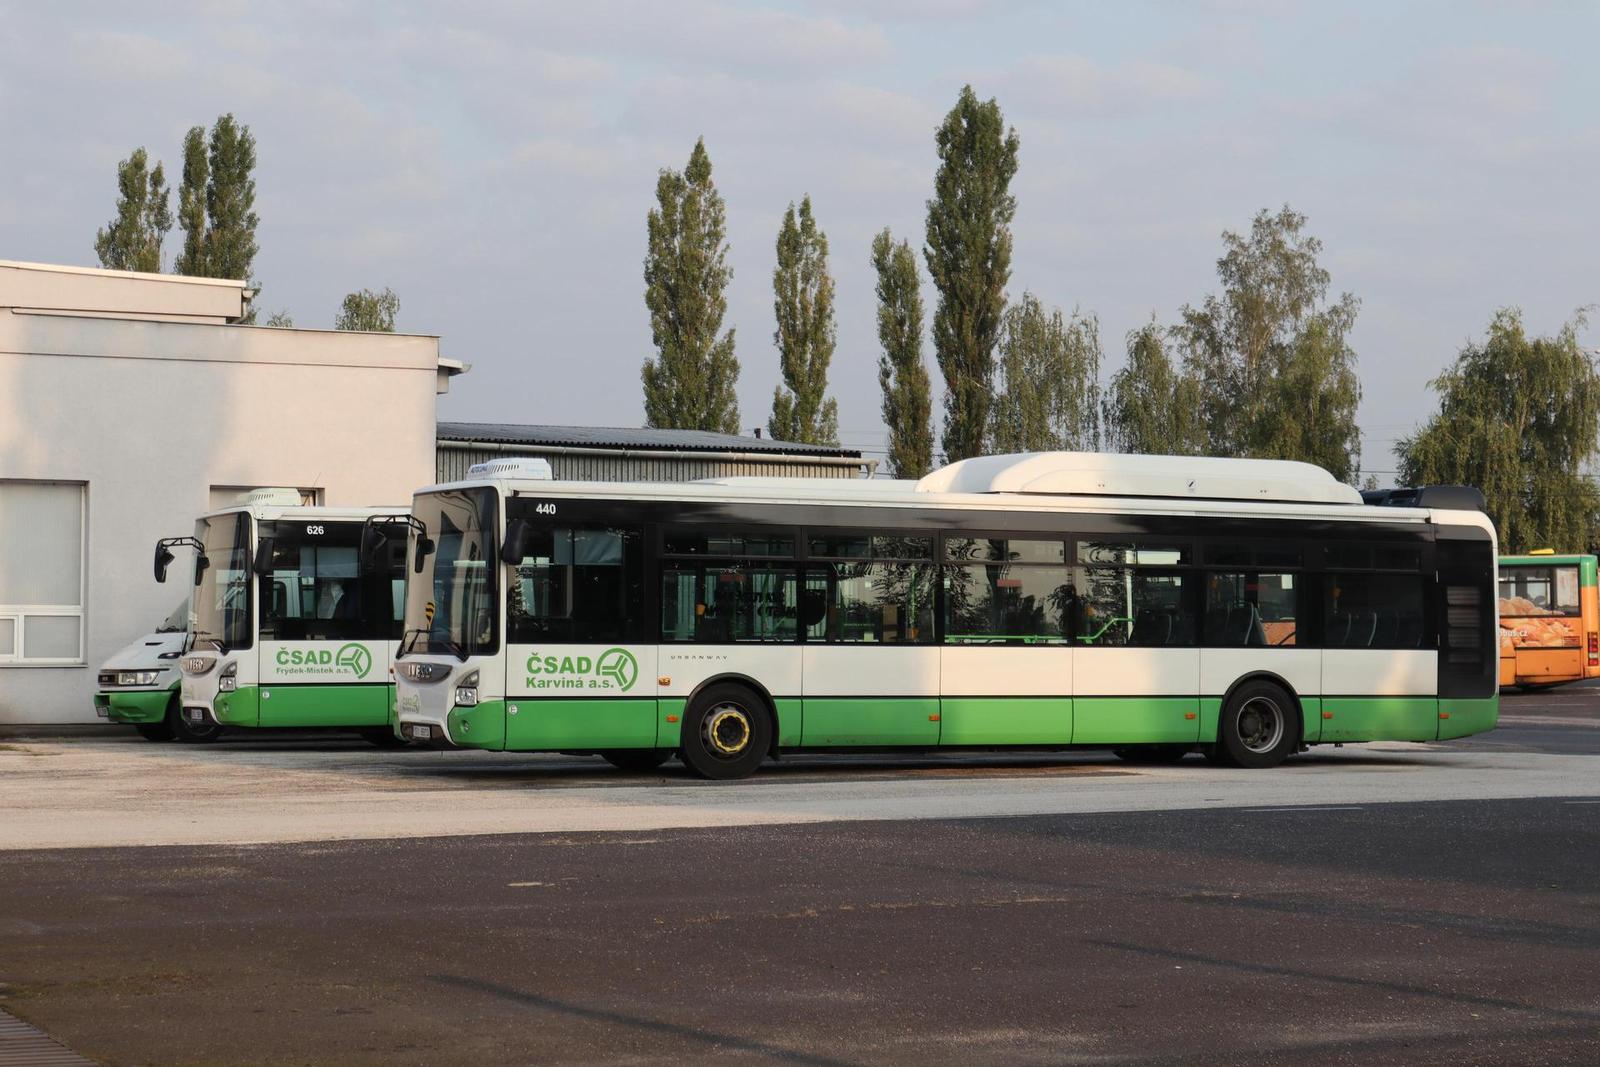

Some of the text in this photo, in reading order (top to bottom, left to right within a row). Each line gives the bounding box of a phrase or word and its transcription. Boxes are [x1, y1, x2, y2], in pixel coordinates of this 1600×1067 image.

[535, 503, 556, 515] 440
[306, 525, 325, 535] 626
[276, 646, 333, 666] ČSAD
[526, 651, 592, 675] ČSAD
[525, 676, 615, 689] Karviná a.s.
